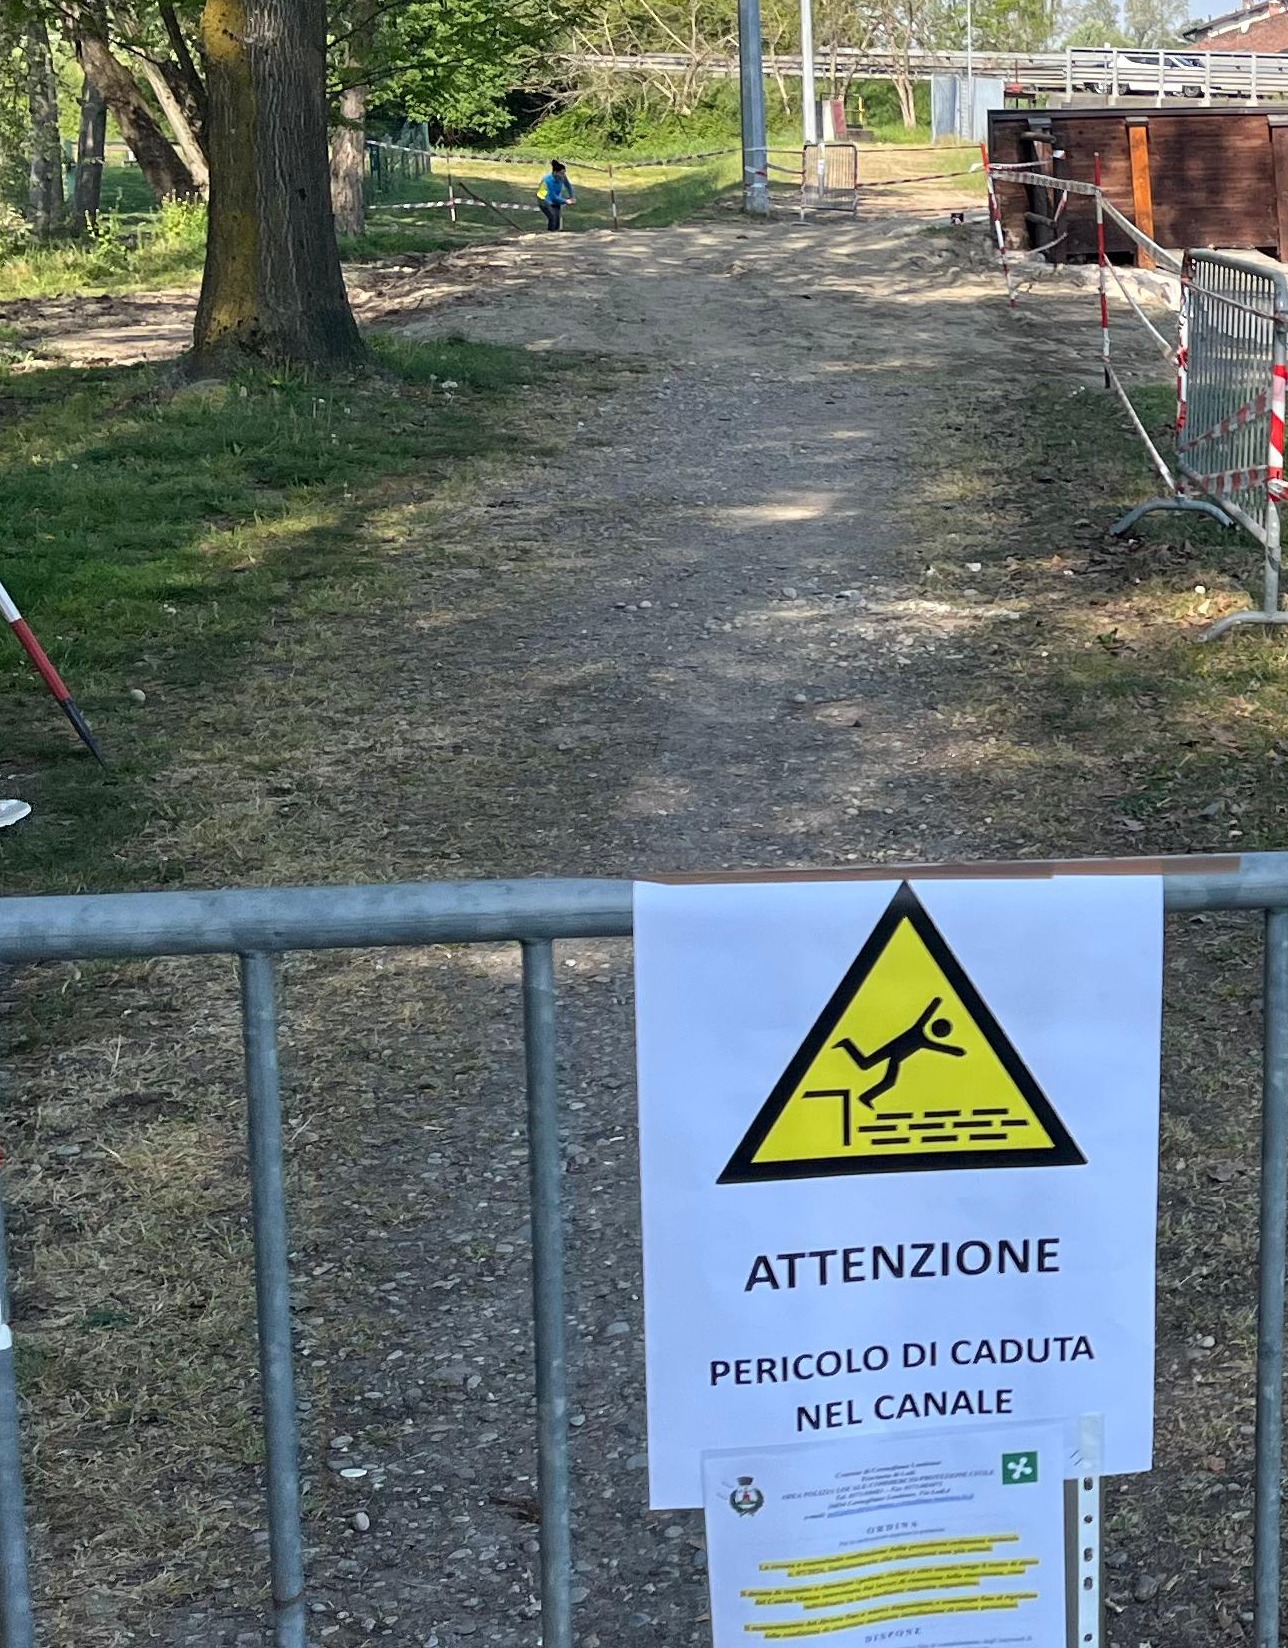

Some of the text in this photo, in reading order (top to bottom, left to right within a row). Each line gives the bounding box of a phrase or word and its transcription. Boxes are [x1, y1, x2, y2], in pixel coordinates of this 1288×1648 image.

[744, 1237, 1060, 1292] ATTENZIONE
[710, 1335, 1095, 1386] PERICOLO DI CADUTA
[796, 1389, 1013, 1432] NEL CANALE
